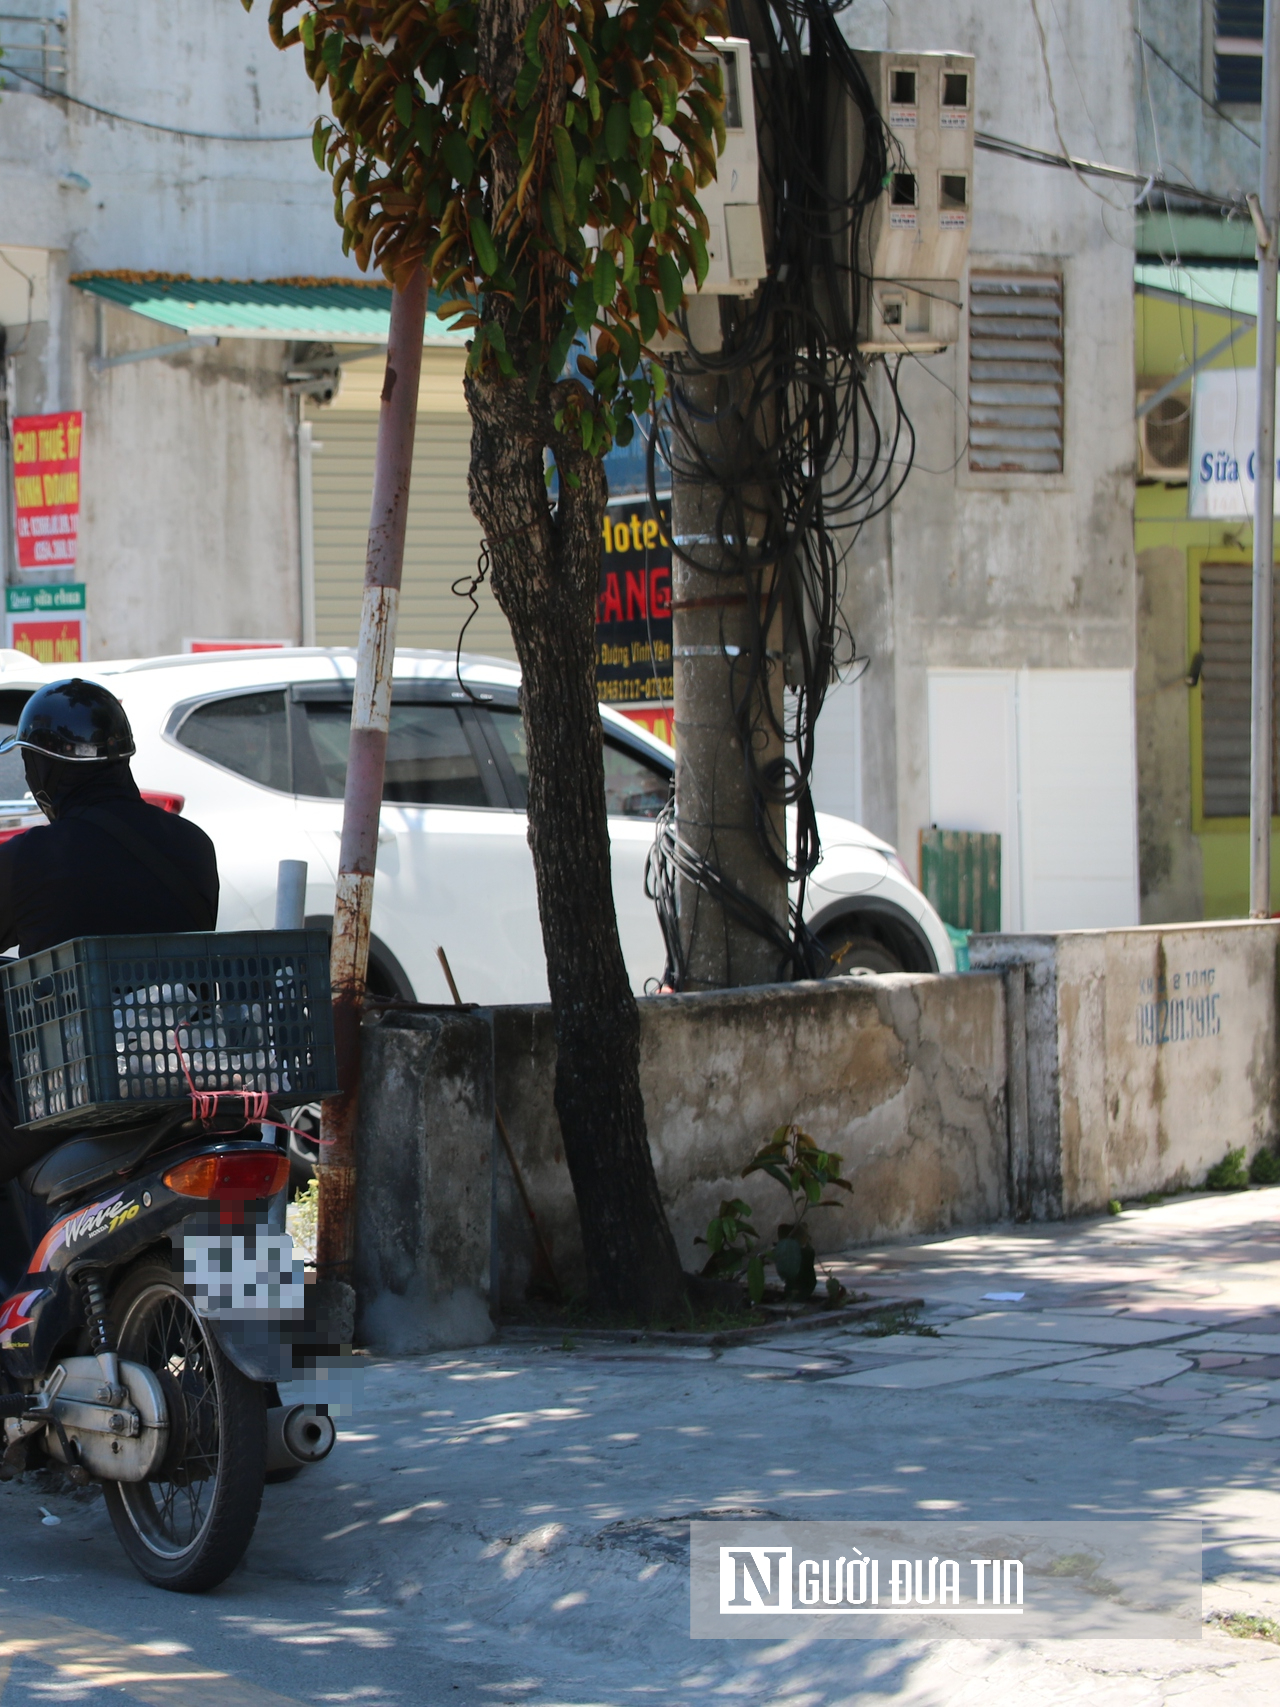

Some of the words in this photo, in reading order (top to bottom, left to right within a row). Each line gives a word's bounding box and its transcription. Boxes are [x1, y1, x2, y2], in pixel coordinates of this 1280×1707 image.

[1199, 450, 1239, 483] Sữa
[595, 566, 672, 624] ANG
[62, 1198, 136, 1249] Wave
[87, 1223, 110, 1239] HONDA
[107, 1203, 140, 1235] 110
